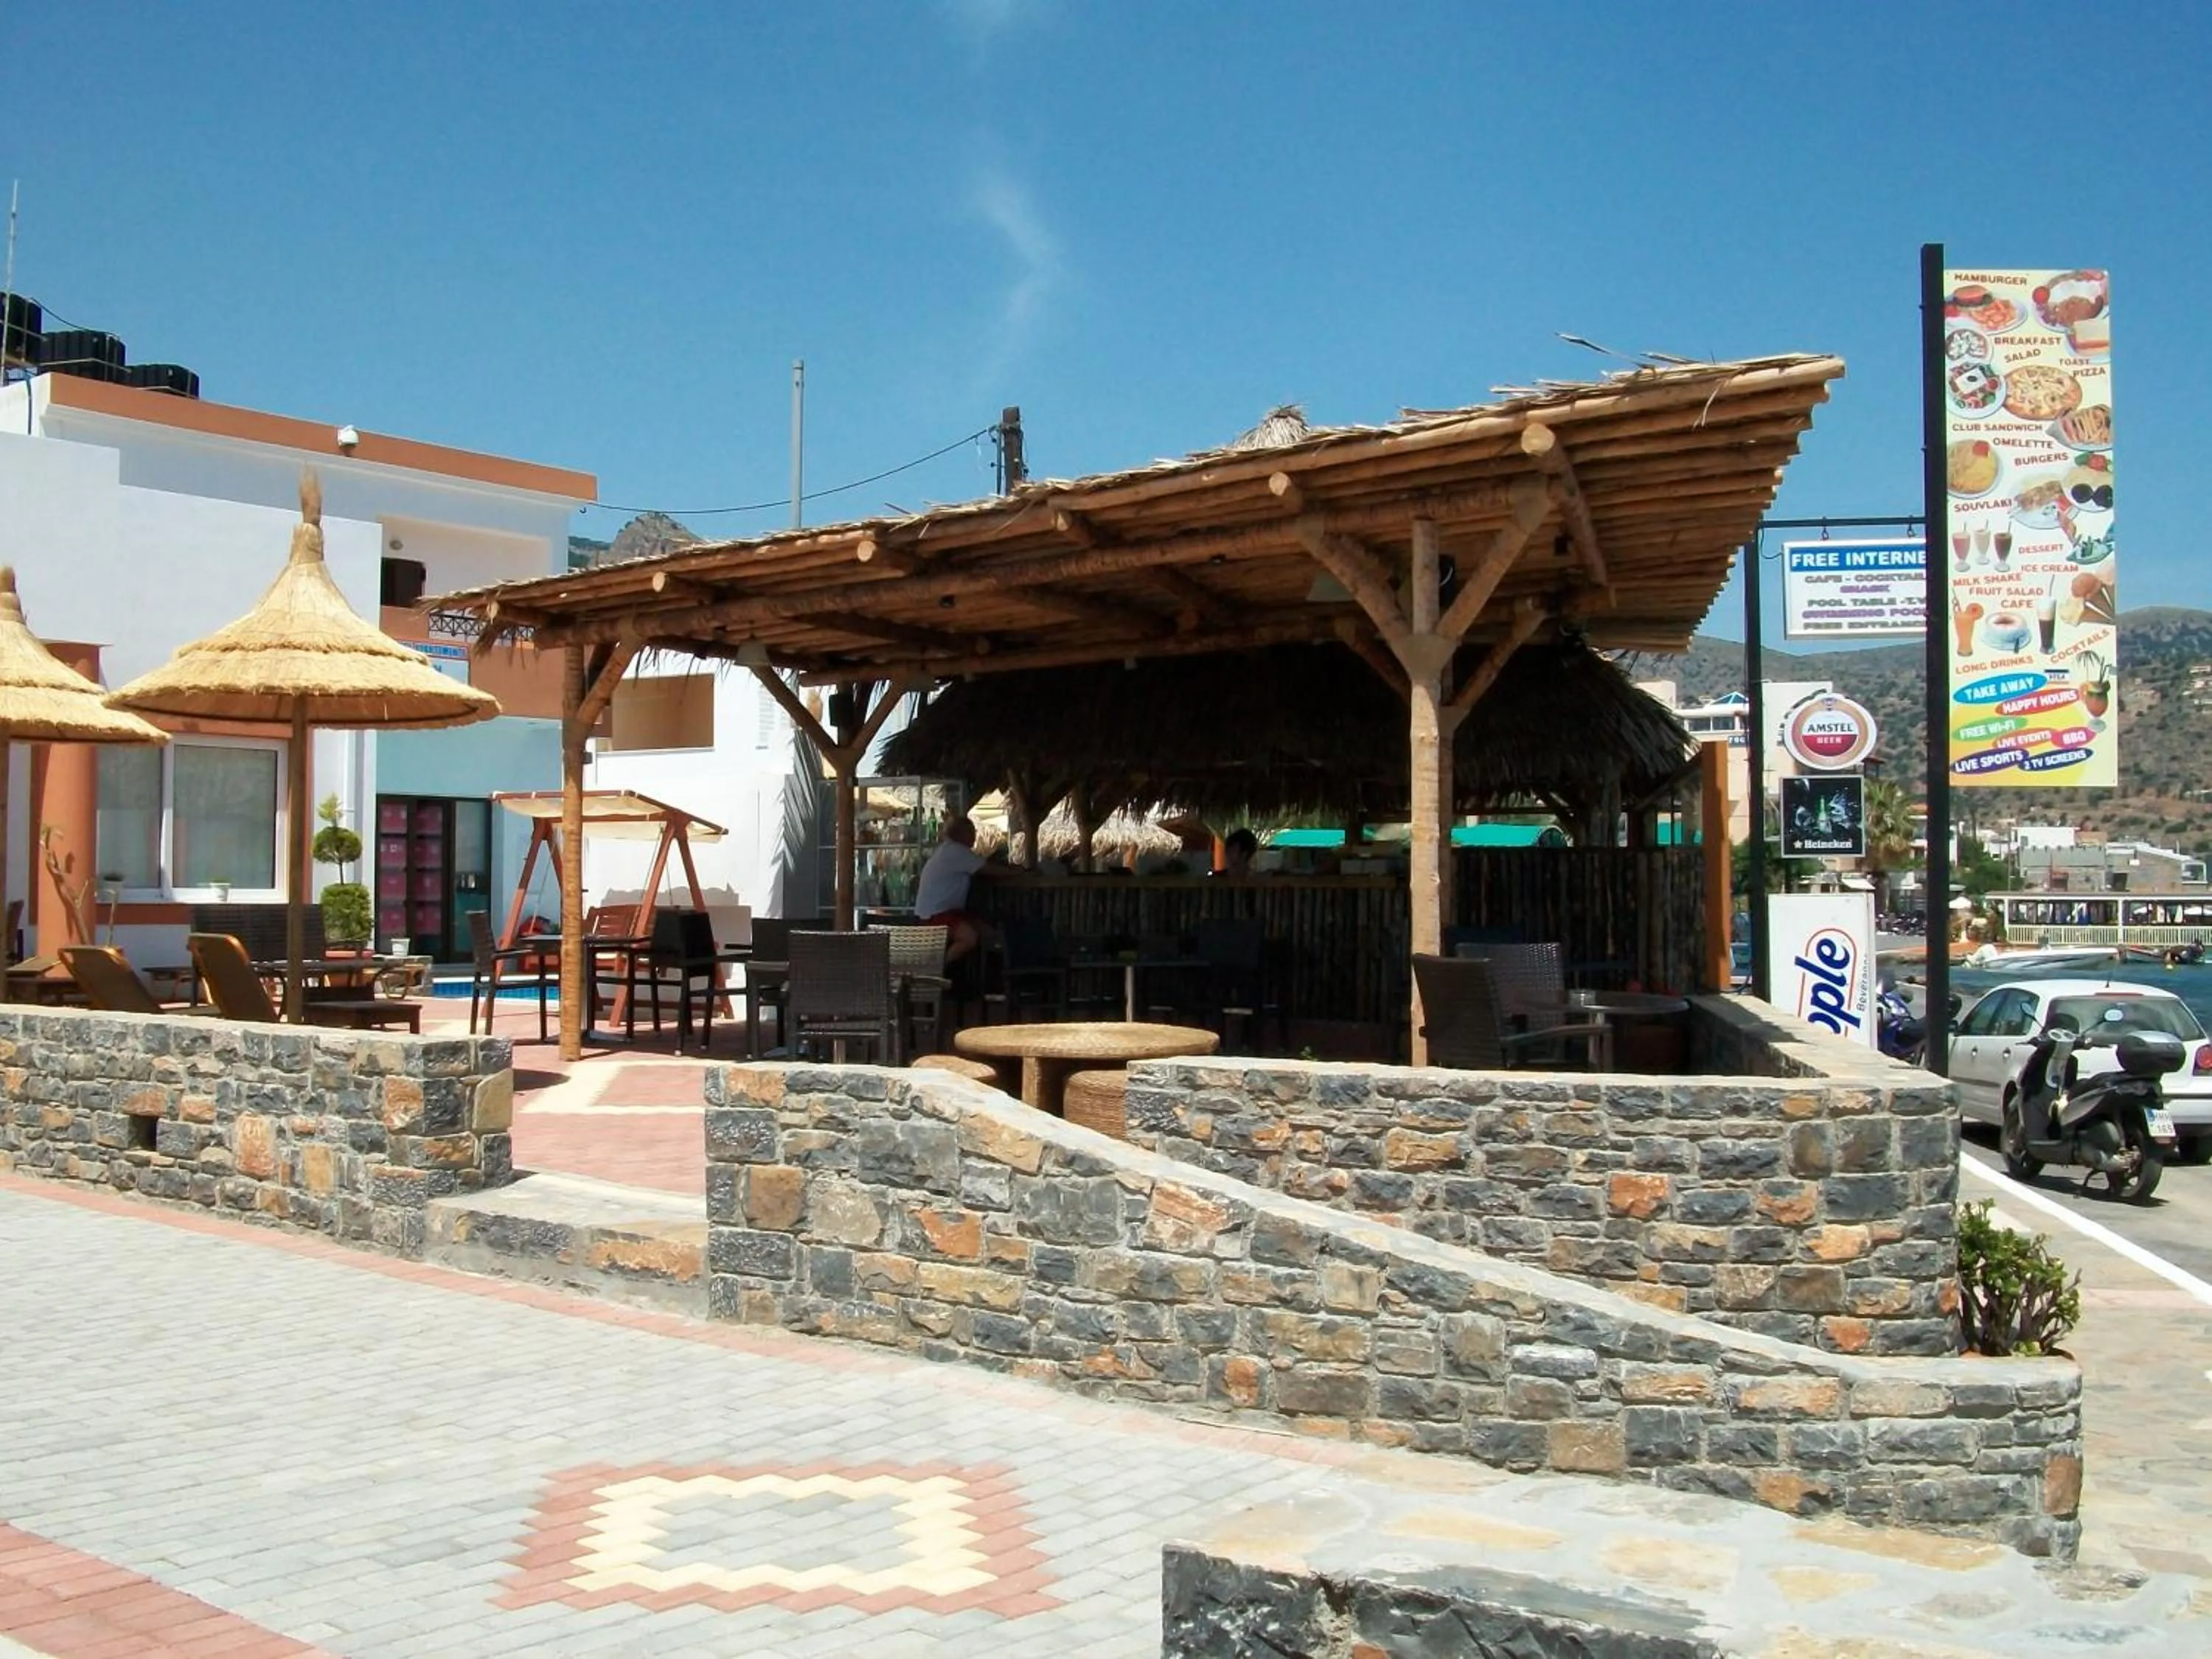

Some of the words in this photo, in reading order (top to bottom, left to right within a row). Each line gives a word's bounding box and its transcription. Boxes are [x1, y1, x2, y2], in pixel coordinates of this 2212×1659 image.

[1954, 273, 2027, 285] HAMBURGER
[1994, 336, 2062, 345] BREAKFAST
[2003, 348, 2041, 363] SALAD
[2073, 366, 2106, 378] PIZZA
[1992, 437, 2053, 449] OMELETTE
[2014, 452, 2069, 466] BURGERS
[1954, 498, 2012, 512] SOUVLAKI
[2018, 543, 2065, 554] DESSERT
[1792, 553, 1839, 567] FREE
[1846, 551, 1927, 566] INTERNE
[2020, 564, 2038, 572] ICE
[2041, 564, 2079, 572] CREAM
[1952, 577, 1981, 586] MILK
[1983, 572, 2023, 585] SHAKE
[1969, 587, 2003, 596] FRUIT
[2006, 587, 2044, 596] SALAD
[1807, 599, 1847, 607] POOL
[1851, 597, 1897, 606] TABLE
[2000, 599, 2034, 608] CAFE
[1847, 620, 1927, 629] ENTRANC
[2050, 628, 2110, 664] COCKTAILS
[1955, 664, 1987, 675] LONG
[1990, 655, 2034, 669] DRINKS
[1964, 685, 1997, 700] TAKE
[2000, 677, 2035, 695] AWAY
[2002, 696, 2038, 714] HAPPY
[2039, 690, 2078, 706] HOURS
[1807, 723, 1853, 733] AMSTEL
[1958, 726, 1987, 739] FREE
[1996, 738, 2017, 748] LIVE
[2017, 730, 2052, 745] EVENTS
[2062, 731, 2087, 745] BBQ
[1955, 758, 1979, 773] LIVE
[1980, 751, 2024, 768] SPORTS
[2031, 759, 2045, 768] TV
[2045, 751, 2087, 767] SCREENS
[1804, 840, 1852, 849] Heineken
